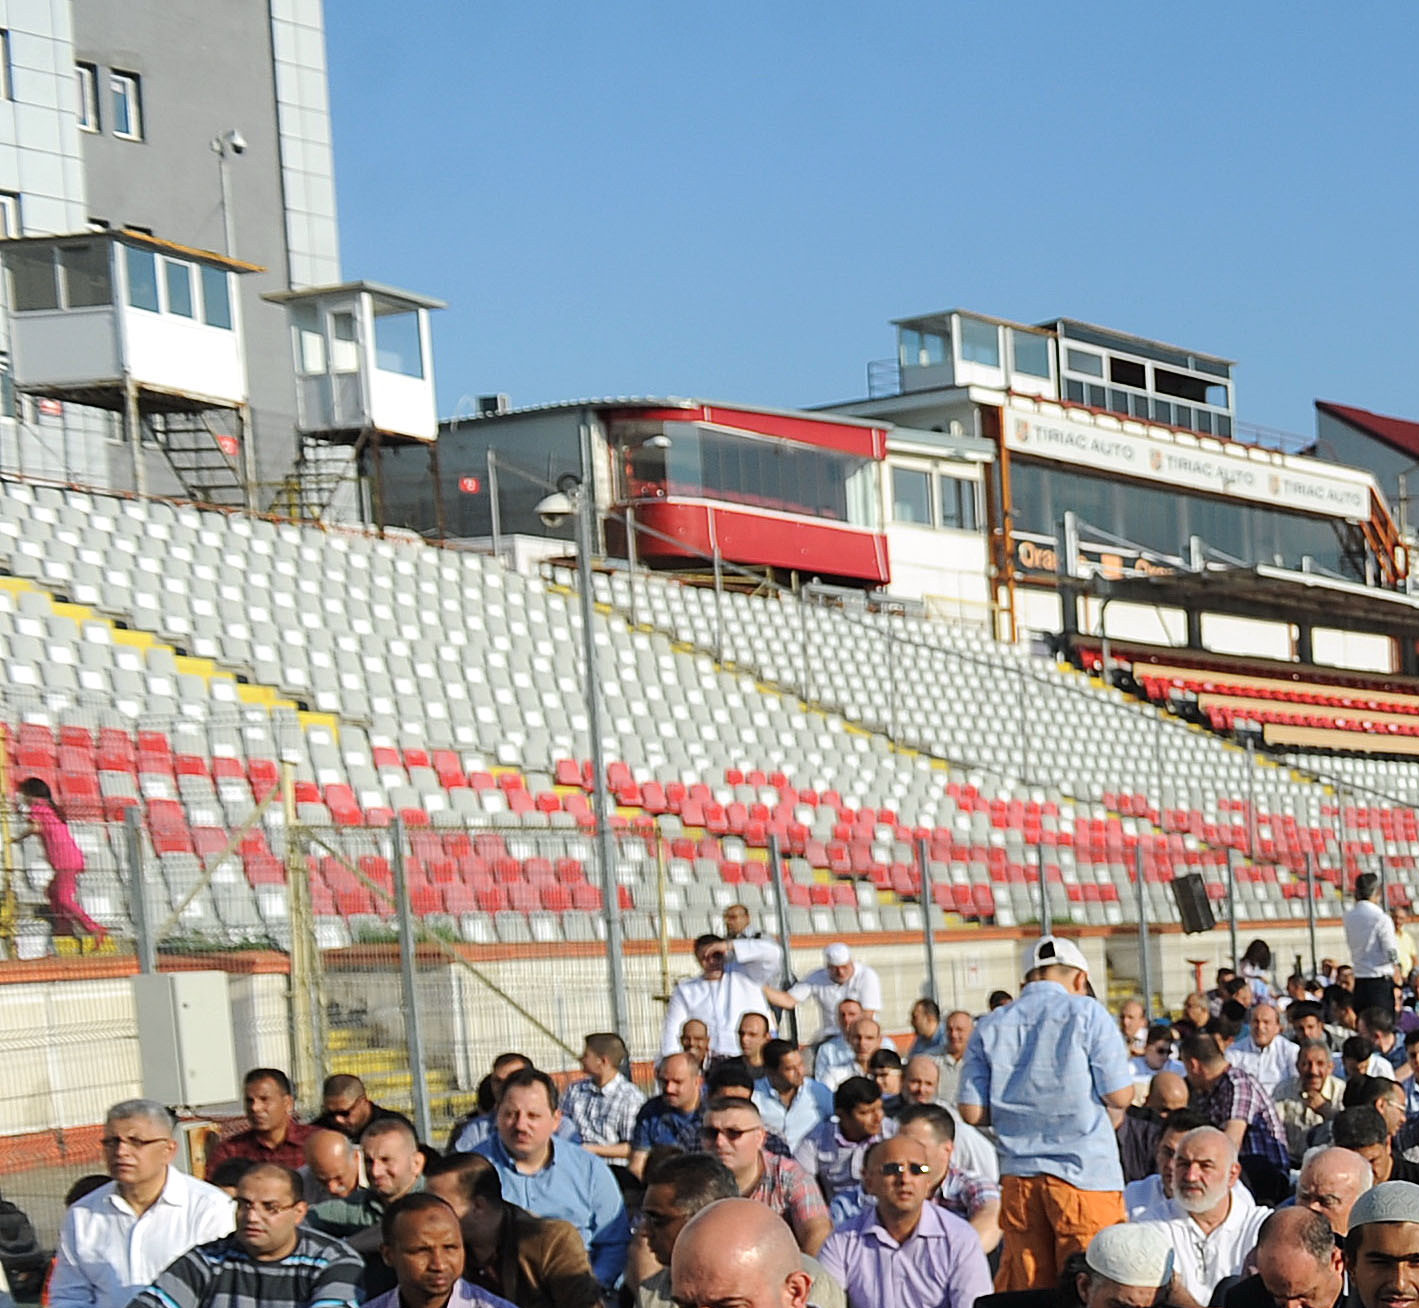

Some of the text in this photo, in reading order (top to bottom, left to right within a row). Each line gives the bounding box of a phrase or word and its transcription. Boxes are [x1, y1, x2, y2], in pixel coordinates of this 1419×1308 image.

[1090, 438, 1136, 460] AUTO
[1215, 467, 1256, 486] AUTO
[1327, 487, 1362, 505] AUTO
